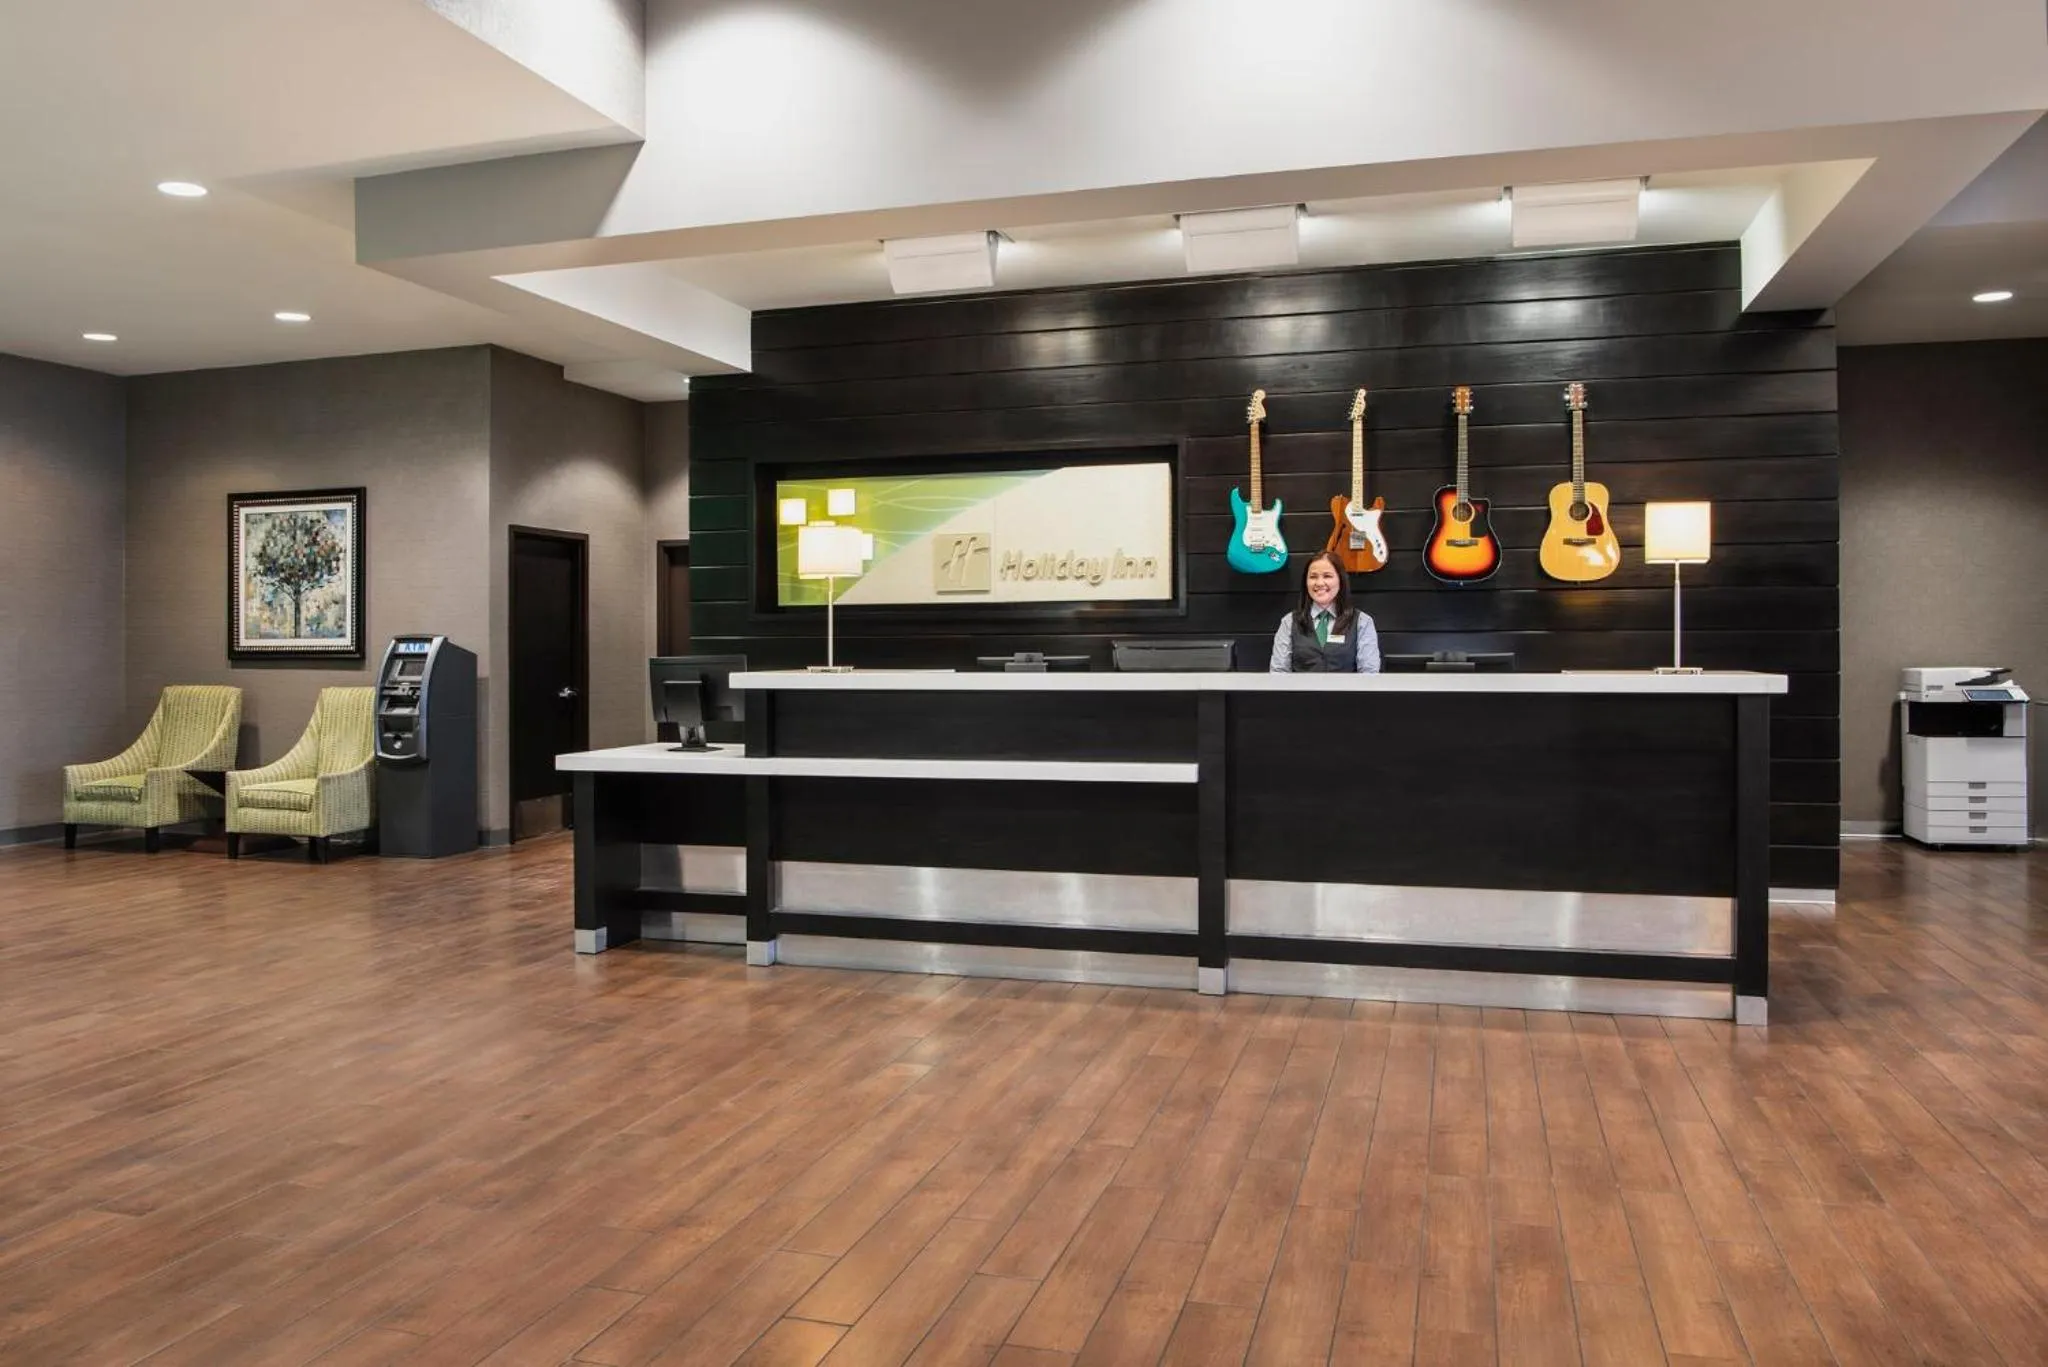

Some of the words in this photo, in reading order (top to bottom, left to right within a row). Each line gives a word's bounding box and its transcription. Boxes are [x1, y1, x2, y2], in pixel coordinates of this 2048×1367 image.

[1000, 549, 1107, 586] Holiday
[1111, 548, 1158, 579] Inn
[404, 642, 426, 652] ATM
